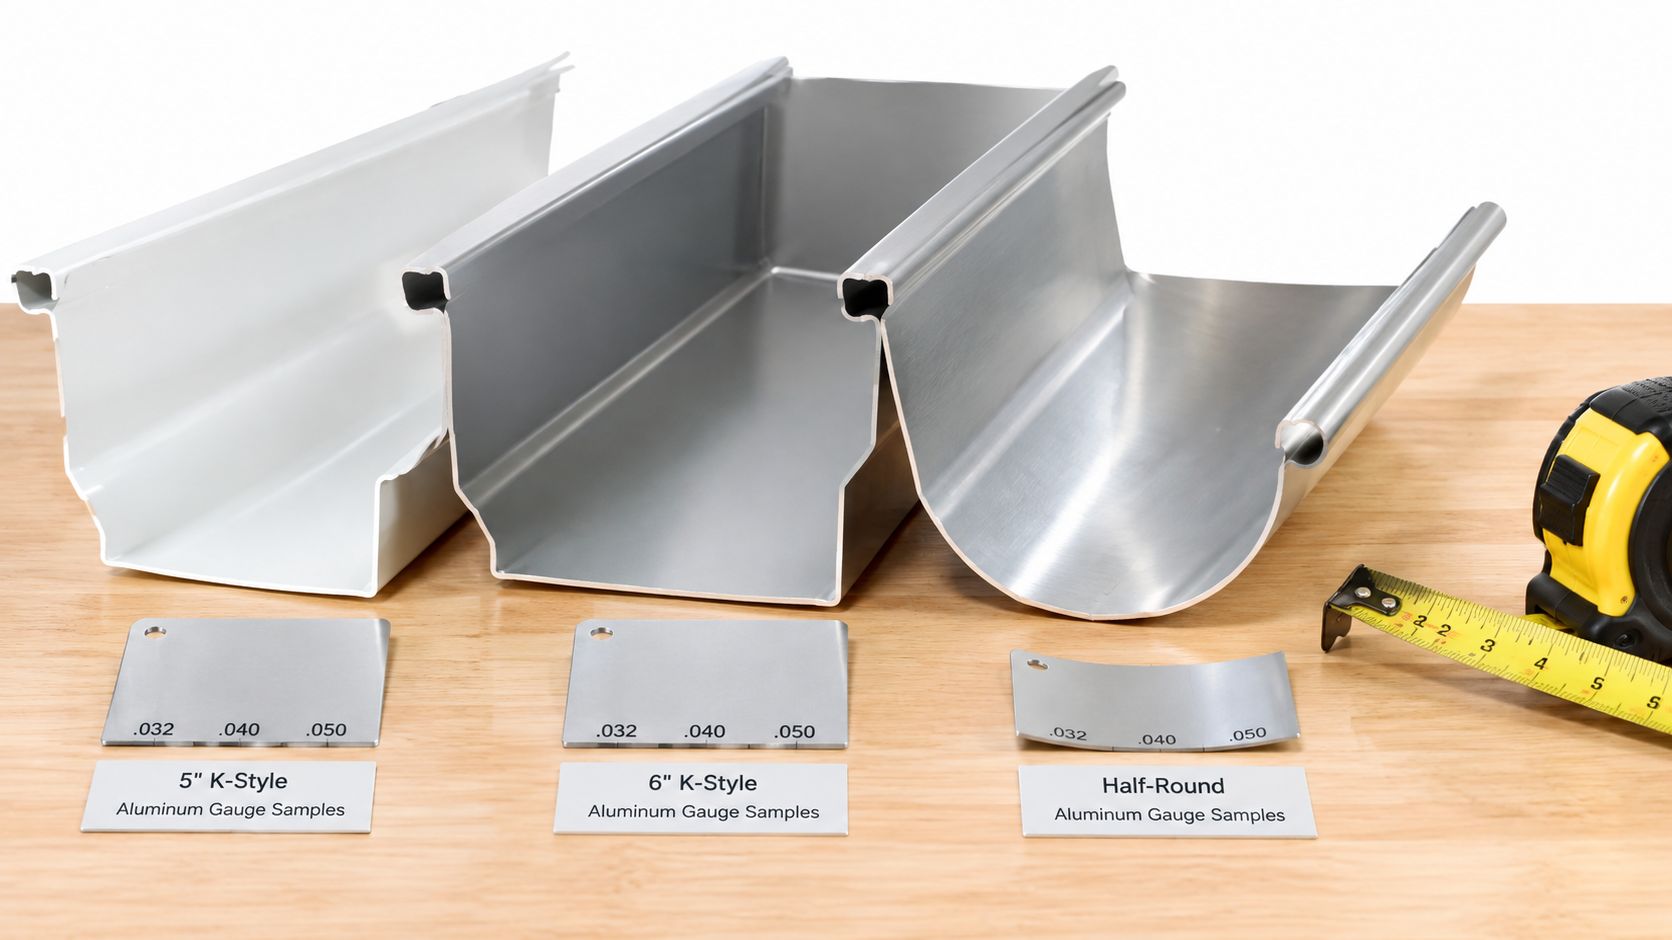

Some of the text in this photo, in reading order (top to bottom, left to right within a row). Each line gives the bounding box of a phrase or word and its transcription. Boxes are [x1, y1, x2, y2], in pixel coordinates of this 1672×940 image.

[1436, 623, 1452, 638] 2
[1480, 638, 1496, 653] 3
[1533, 657, 1548, 671] 4
[133, 722, 347, 737] .032 .040 .050
[596, 723, 816, 739] .032 .040 .050
[1049, 726, 1268, 746] .032 .040 .050
[179, 772, 288, 794] 5" K-Style
[648, 774, 758, 796] 6" K-Style
[1102, 776, 1225, 794] Half-Round
[116, 802, 345, 820] Aluminum Gauge Samples
[587, 804, 820, 822] Aluminum Gauge Samples
[1054, 807, 1286, 825] Aluminum Gauge Samples
